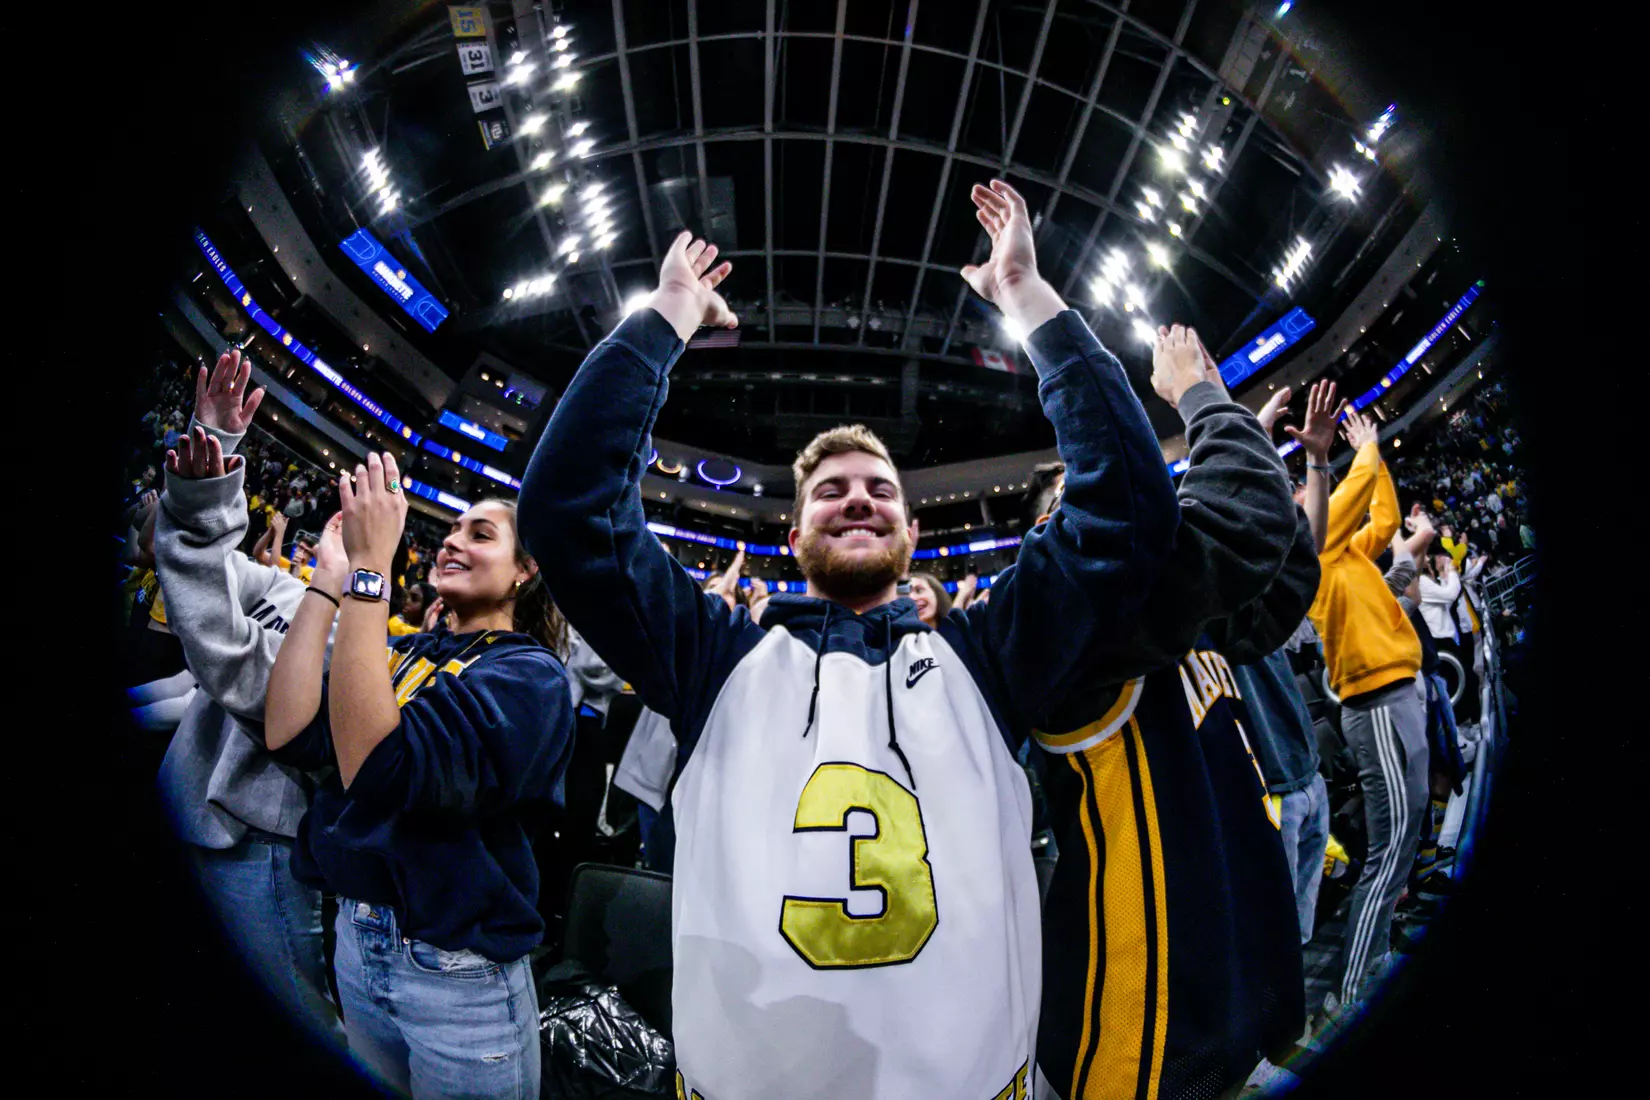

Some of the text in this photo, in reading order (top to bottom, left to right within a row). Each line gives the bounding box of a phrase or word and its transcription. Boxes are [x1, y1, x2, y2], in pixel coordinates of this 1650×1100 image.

[468, 49, 485, 70] 31
[479, 89, 494, 104] 3
[206, 246, 226, 272] EAGLES
[909, 657, 934, 678] NIKE
[779, 761, 939, 970] 3
